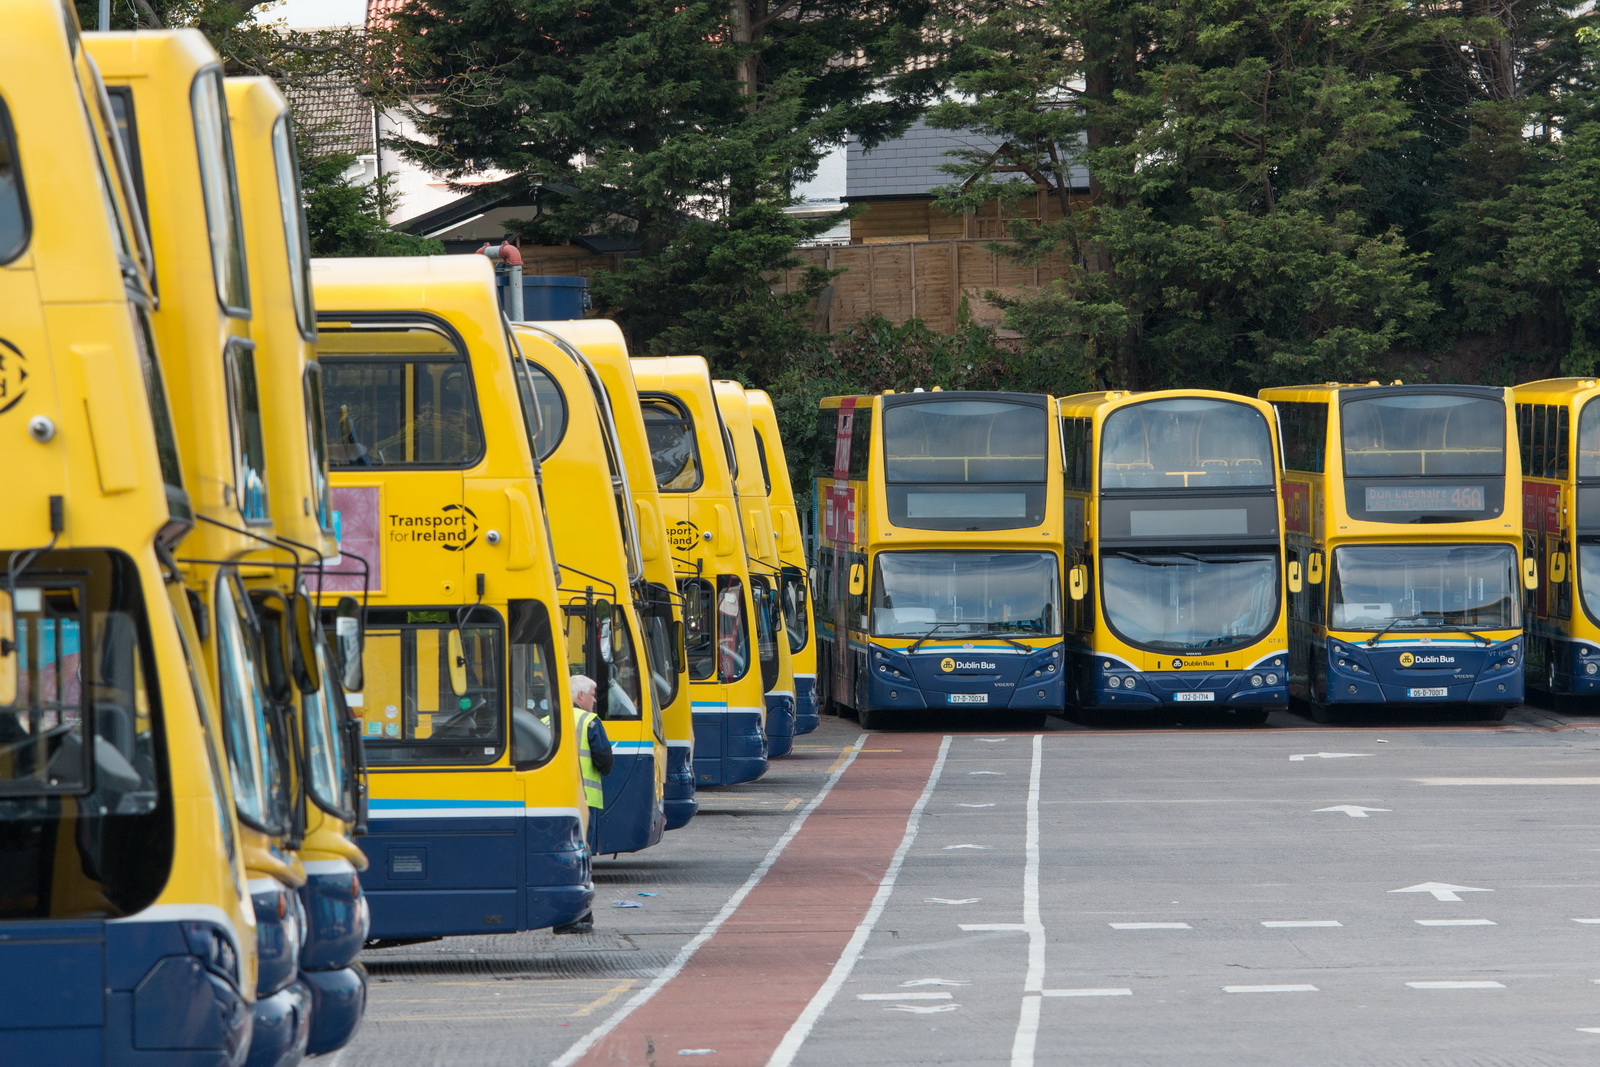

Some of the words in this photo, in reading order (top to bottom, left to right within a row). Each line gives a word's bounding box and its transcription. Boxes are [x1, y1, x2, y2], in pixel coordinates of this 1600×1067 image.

[1451, 487, 1482, 508] 46A
[389, 514, 466, 528] Transport
[390, 530, 408, 542] for
[411, 528, 466, 542] Ireland
[668, 537, 692, 545] land
[1415, 655, 1439, 663] Dublin
[1440, 655, 1455, 663] Bus
[956, 661, 980, 669] Dublin
[981, 661, 996, 669] Bus
